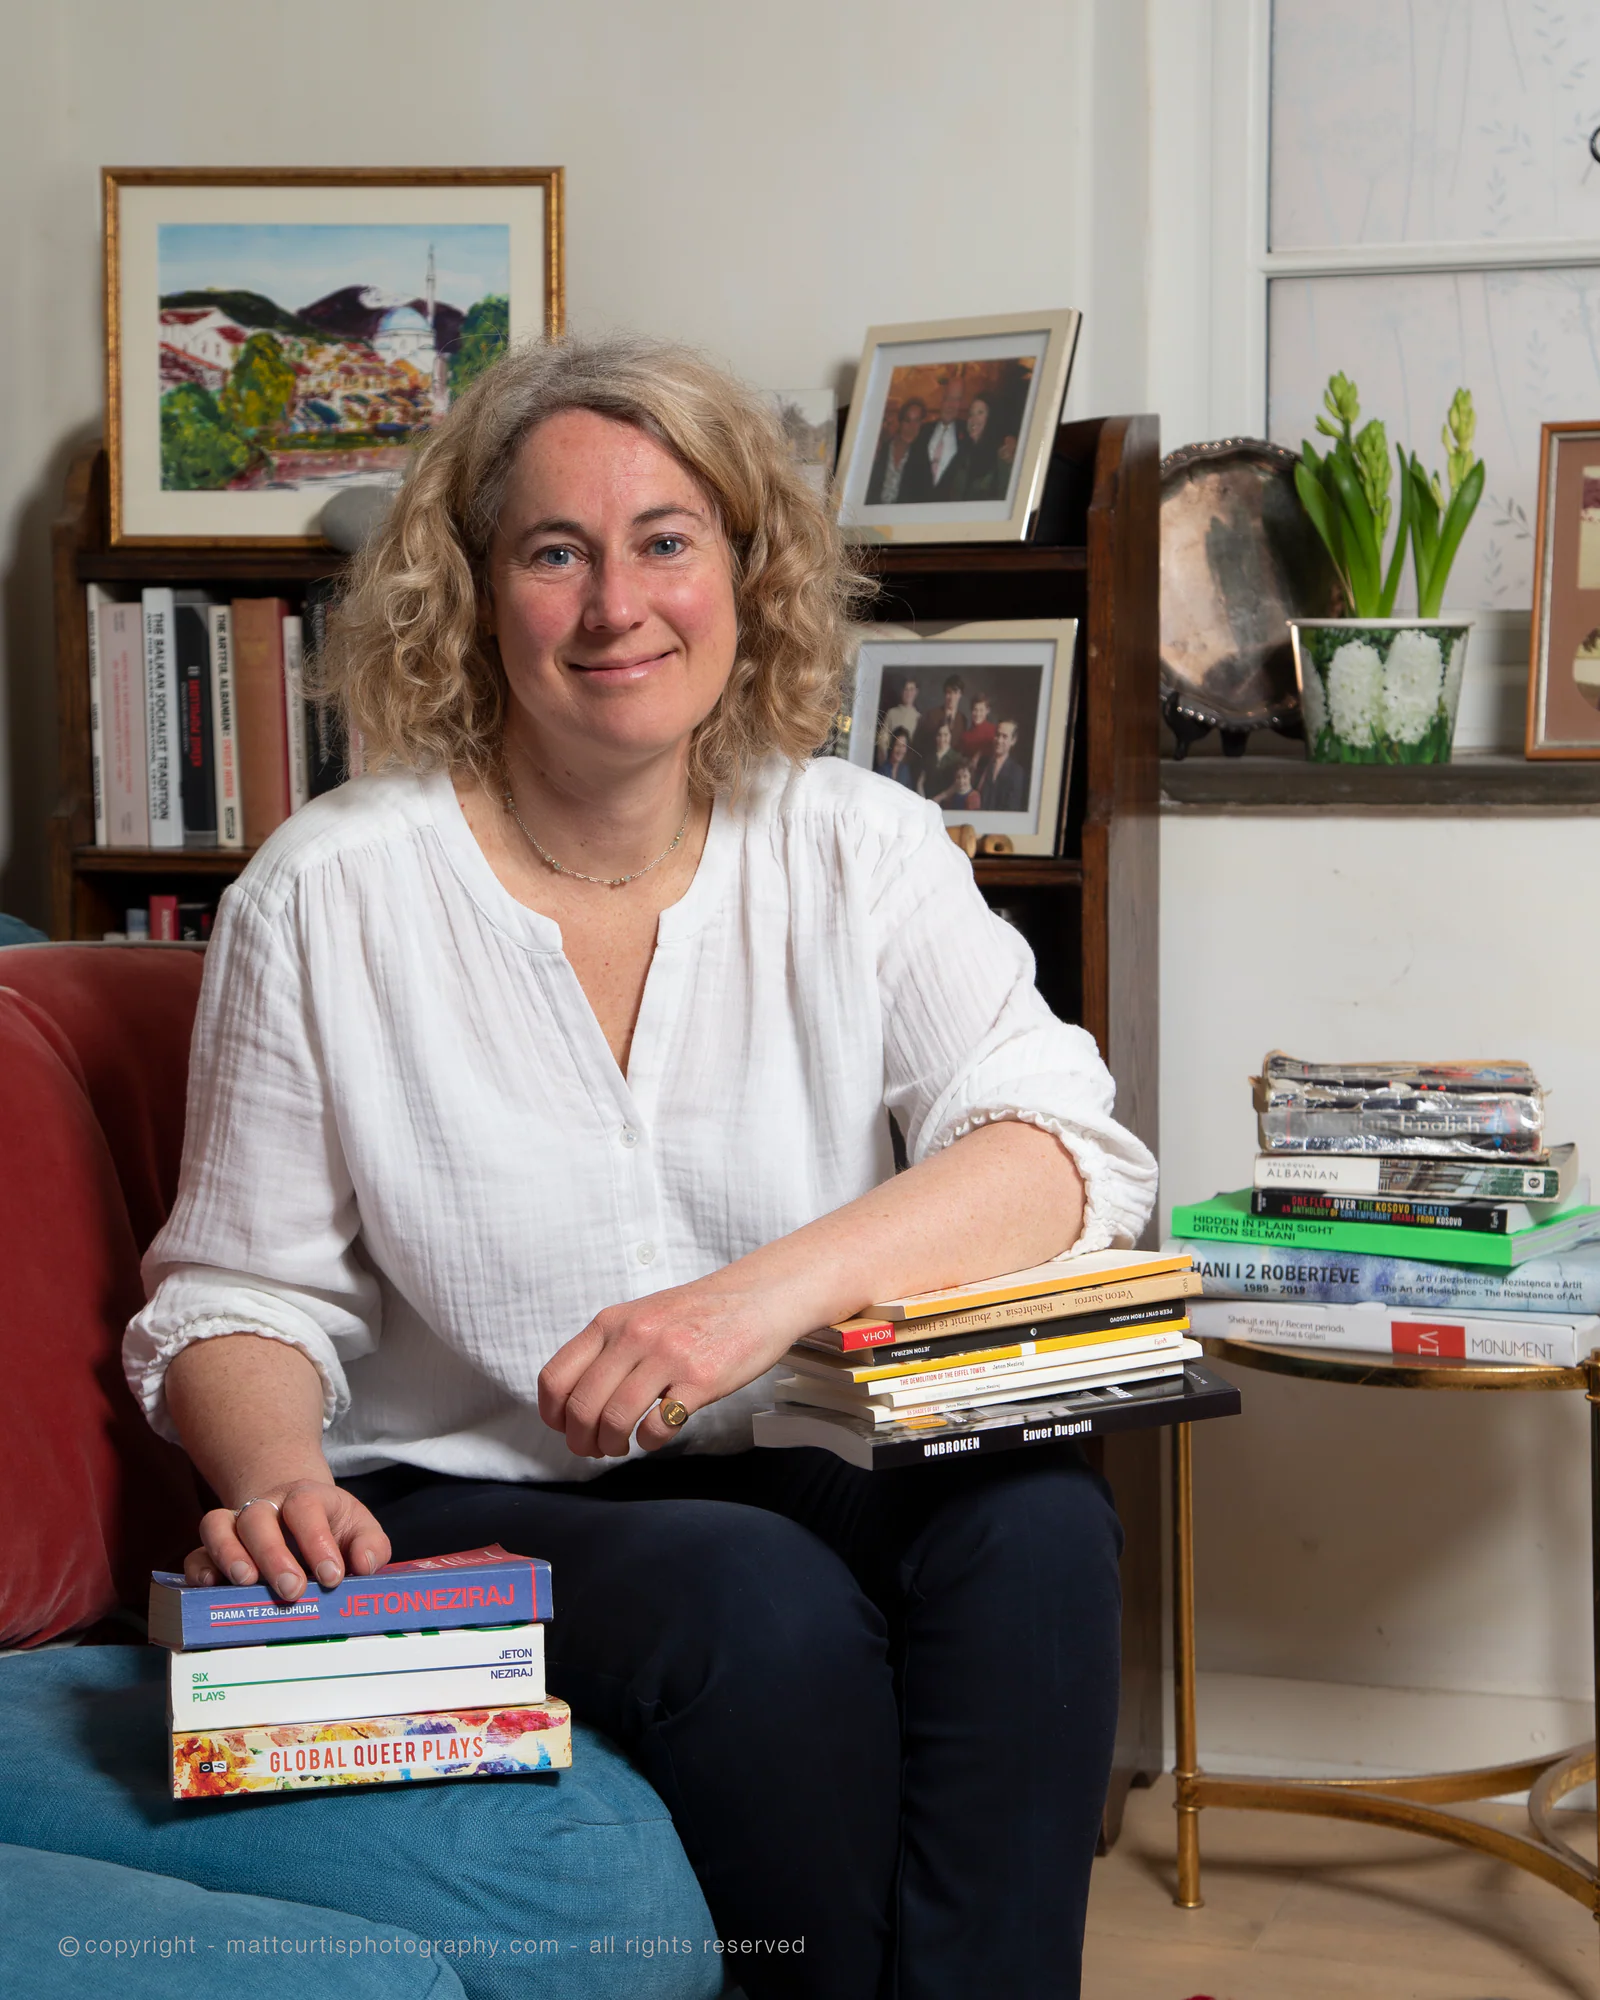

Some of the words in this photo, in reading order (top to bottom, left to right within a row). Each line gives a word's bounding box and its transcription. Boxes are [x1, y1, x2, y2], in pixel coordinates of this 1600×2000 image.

[154, 612, 164, 635] THE
[216, 614, 227, 633] THE
[217, 634, 229, 676] ARTFUL
[155, 639, 166, 689] BALKAN
[219, 678, 232, 737] ALBANIAN:
[156, 692, 168, 753] SOCIALIST
[157, 755, 170, 821] TRADITION
[1266, 1168, 1339, 1181] ALBANIAN
[1291, 1195, 1308, 1206] ONE
[1309, 1197, 1333, 1208] FLEW
[1333, 1199, 1356, 1210] OVER
[1358, 1201, 1373, 1212] THE
[1375, 1201, 1410, 1214] KOSOVO
[1412, 1204, 1449, 1216] THEATER
[1282, 1204, 1291, 1213] AN
[1292, 1206, 1329, 1216] ANTHOLOGY
[1330, 1208, 1338, 1217] OF
[1340, 1209, 1391, 1220] CONTEMPORARY
[1392, 1213, 1415, 1223] DRAMA
[1416, 1215, 1434, 1224] FROM
[1436, 1215, 1463, 1227] KOSOVO
[1193, 1215, 1239, 1226] HIDDEN
[1242, 1219, 1254, 1228] IN
[1258, 1220, 1293, 1232] PLAIN
[1297, 1224, 1334, 1235] SIGHT
[1193, 1225, 1237, 1236] DRITON
[1242, 1227, 1296, 1240] SELMANI
[1191, 1261, 1230, 1278] HANI
[1236, 1263, 1241, 1278] I
[1245, 1263, 1256, 1279] 2
[1243, 1284, 1269, 1293] 1989
[1416, 1274, 1432, 1283] Arti
[1501, 1278, 1551, 1289] Rezistenca
[1562, 1280, 1583, 1290] Artit
[1074, 1293, 1104, 1306] Surroi
[1105, 1289, 1134, 1301] Veton
[1381, 1284, 1397, 1293] The
[1400, 1285, 1413, 1294] Art
[1416, 1285, 1425, 1294] of
[1427, 1286, 1477, 1296] Resistance
[1484, 1289, 1501, 1298] The
[1504, 1290, 1554, 1300] Resistance
[1557, 1291, 1566, 1300] of
[1568, 1291, 1583, 1301] Art
[996, 1310, 1002, 1318] e
[1006, 1302, 1053, 1320] Fshehtësia
[1130, 1312, 1145, 1320] FROM
[1146, 1310, 1159, 1318] GYNT
[907, 1321, 937, 1334] Hanës
[939, 1319, 948, 1329] të
[951, 1311, 992, 1328] zbulimit
[1109, 1315, 1130, 1324] KOSOVO
[1228, 1315, 1257, 1327] Shekujt
[1286, 1320, 1313, 1330] Recent
[1315, 1324, 1345, 1334] periods
[862, 1329, 892, 1342] KOHA
[891, 1348, 914, 1358] NEZIRAJ
[914, 1345, 931, 1354] JETON
[1471, 1338, 1554, 1360] MONUMENT
[900, 1378, 909, 1386] THE
[909, 1375, 938, 1385] DEMOLITION
[944, 1371, 954, 1379] THE
[954, 1369, 969, 1377] EIFFEL
[970, 1366, 986, 1375] TOWER
[1007, 1360, 1025, 1369] Neziraj
[912, 1407, 927, 1415] SHADES
[923, 1437, 980, 1457] UNBROKEN
[1023, 1427, 1052, 1441] Enver
[1054, 1420, 1092, 1437] Dugolli
[210, 1608, 245, 1621] DRAMA
[247, 1605, 259, 1617] TË
[261, 1604, 319, 1617] ZGJEDHURA
[499, 1648, 533, 1659] JETON
[192, 1672, 209, 1683] SIX
[490, 1668, 533, 1679] NEZIRAJ
[192, 1690, 226, 1702] PLAYS
[270, 1746, 347, 1773] GLOBAL
[354, 1741, 416, 1767] QUEER
[422, 1736, 484, 1762] PLAYS
